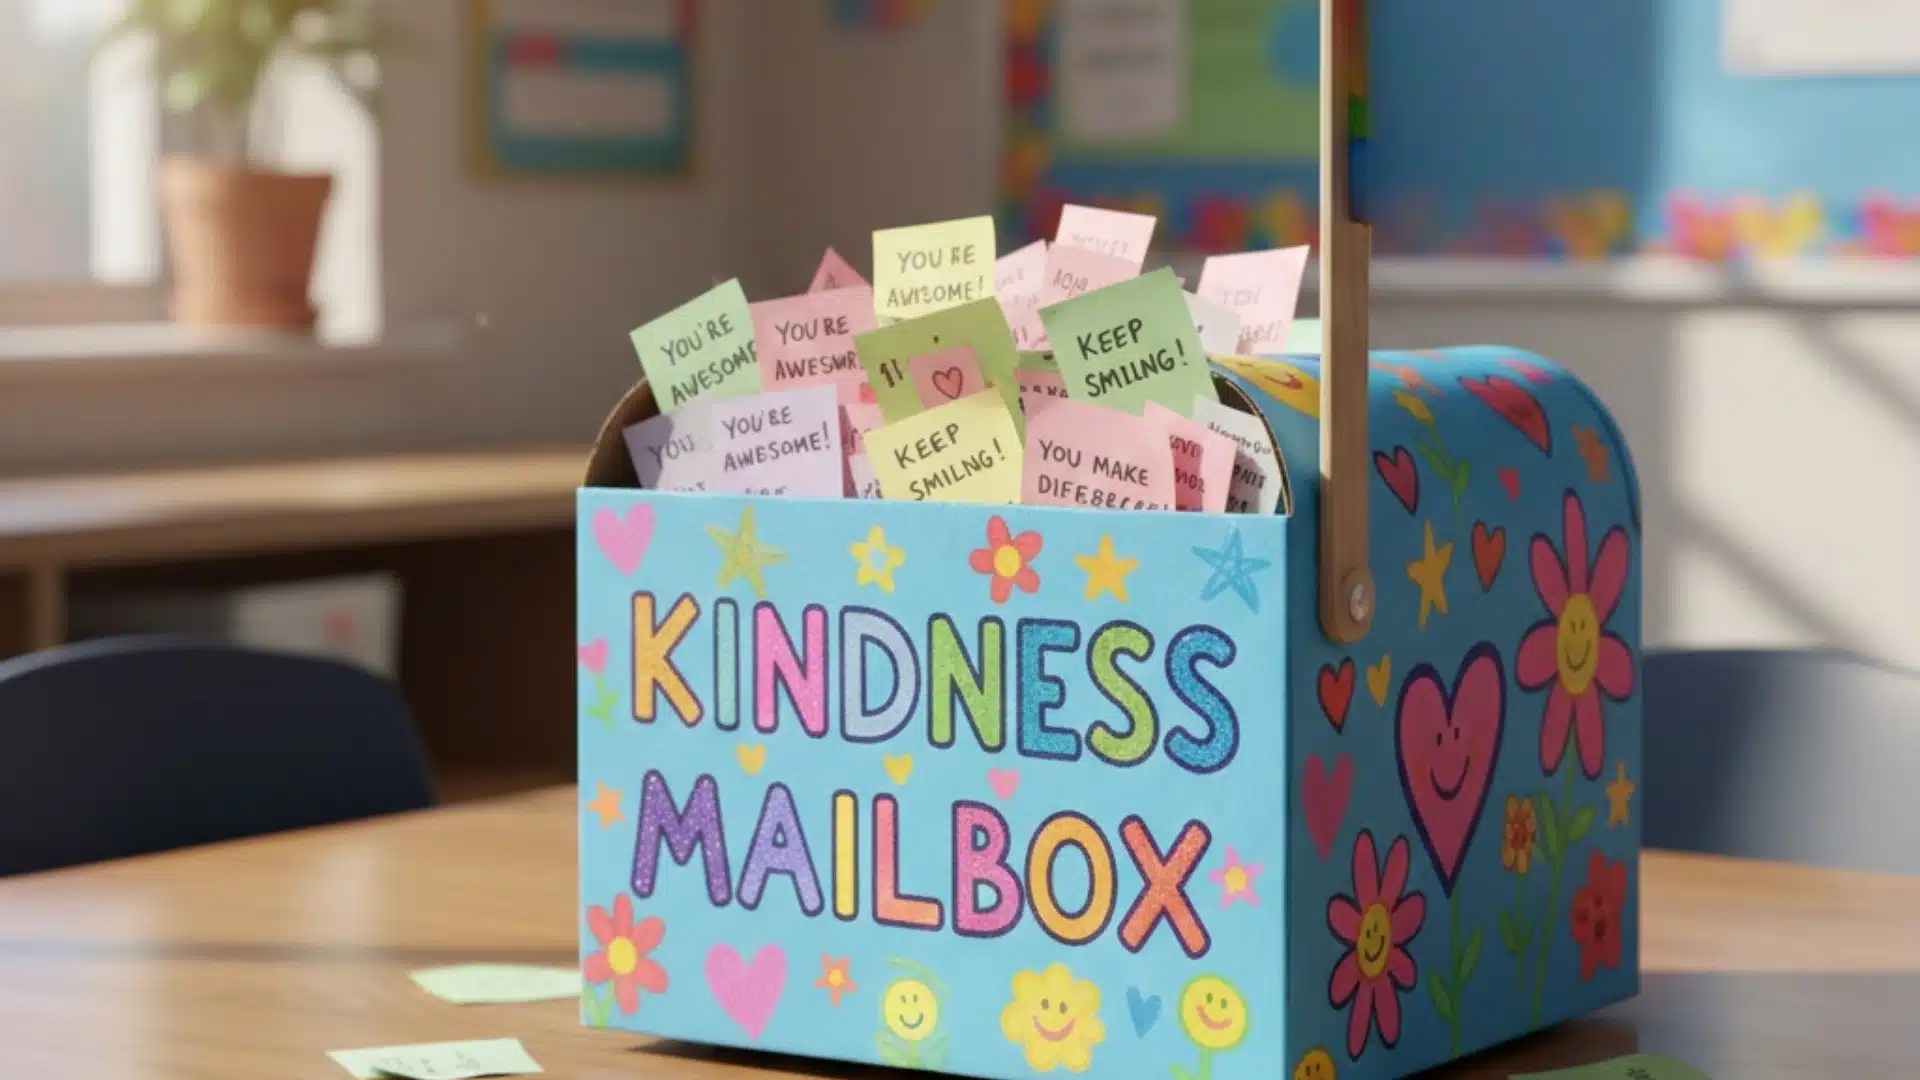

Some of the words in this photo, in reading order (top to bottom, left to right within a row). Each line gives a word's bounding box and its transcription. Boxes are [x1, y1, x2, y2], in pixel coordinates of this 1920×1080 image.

[660, 313, 734, 366] YOU'RE
[1077, 317, 1143, 360] KEEP
[724, 420, 831, 473] AWESOME!
[894, 422, 960, 469] KEEP
[909, 438, 1006, 501] SMILNG!
[1039, 439, 1081, 468] YOU
[1093, 455, 1149, 486] MAKE
[631, 591, 1241, 775] KINDNESS
[631, 769, 1212, 959] MAILBOX
